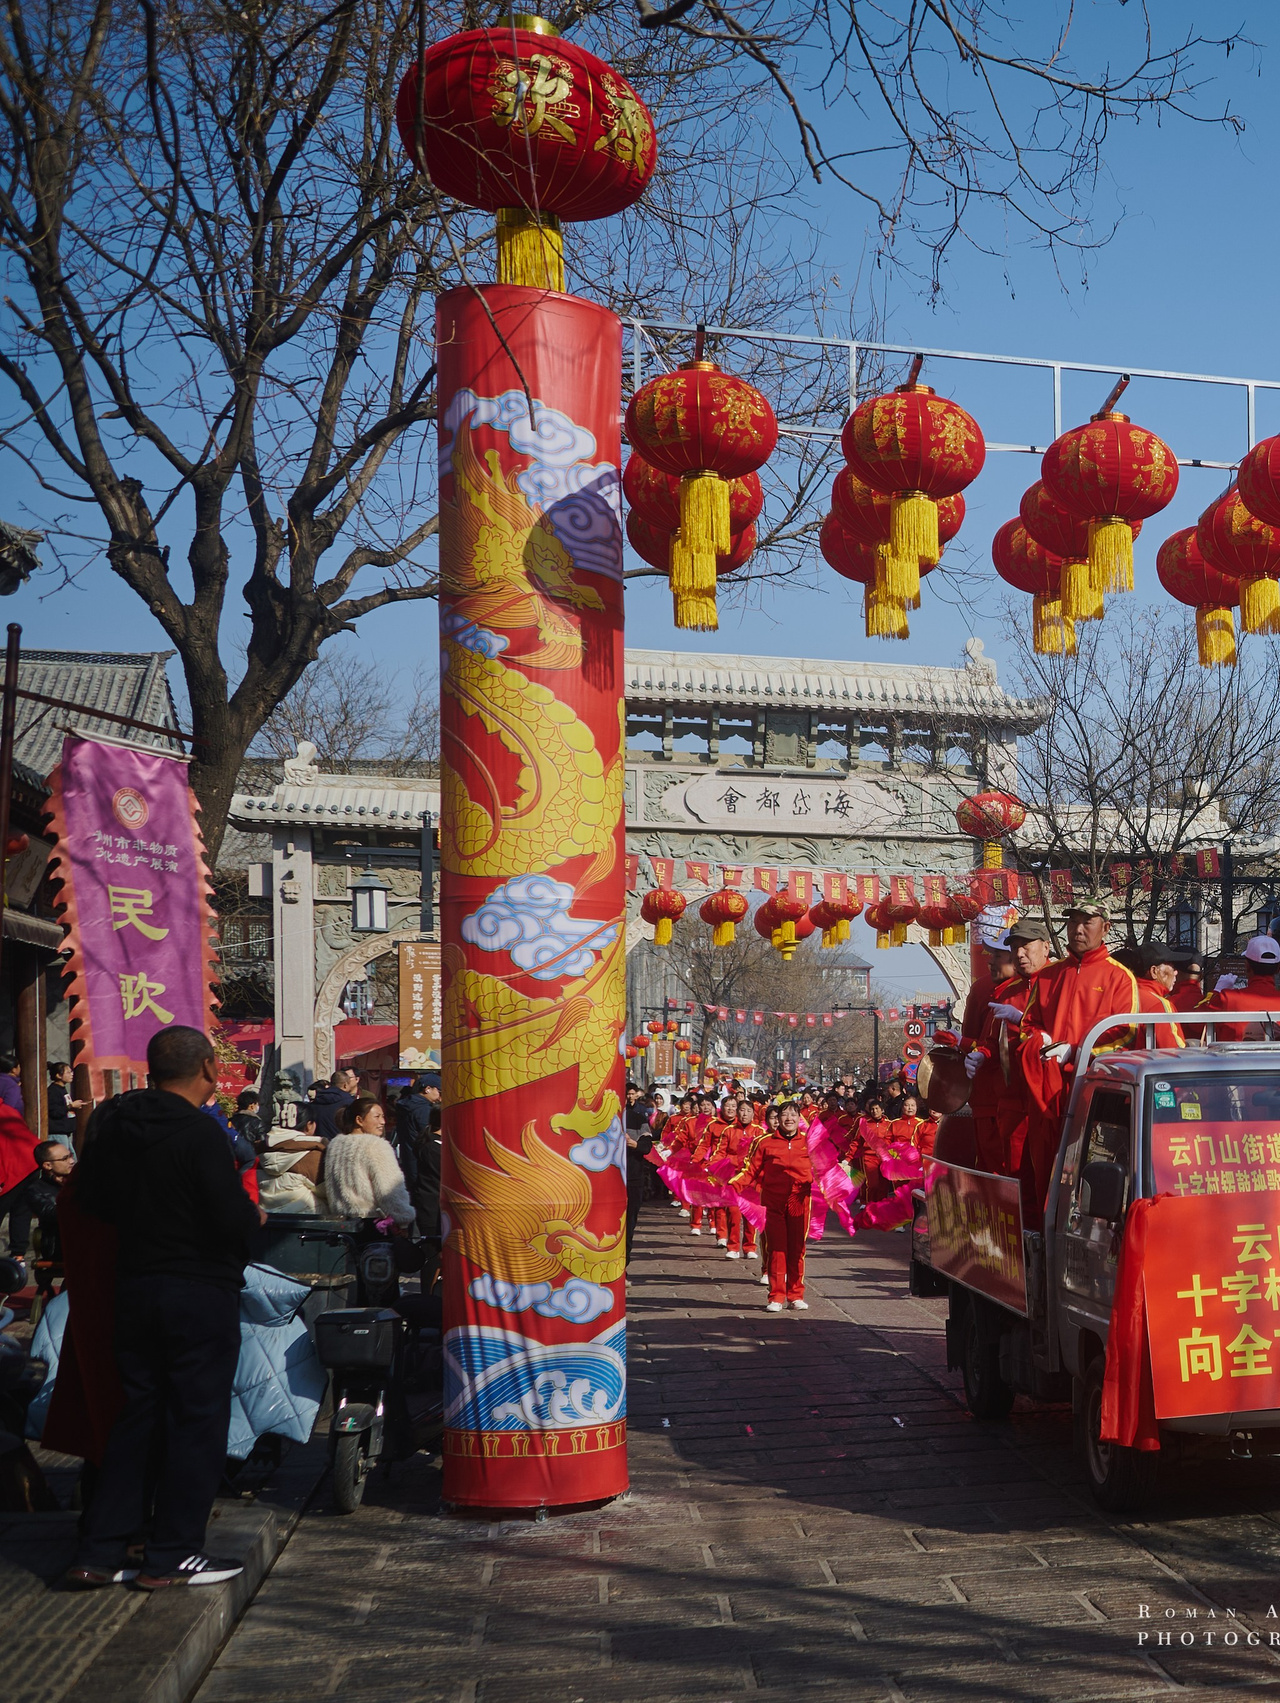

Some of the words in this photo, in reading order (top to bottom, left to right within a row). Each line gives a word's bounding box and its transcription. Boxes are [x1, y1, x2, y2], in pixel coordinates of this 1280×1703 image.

[897, 879, 908, 902] 民主
[108, 884, 175, 1025] 民歌
[908, 1024, 921, 1035] 20
